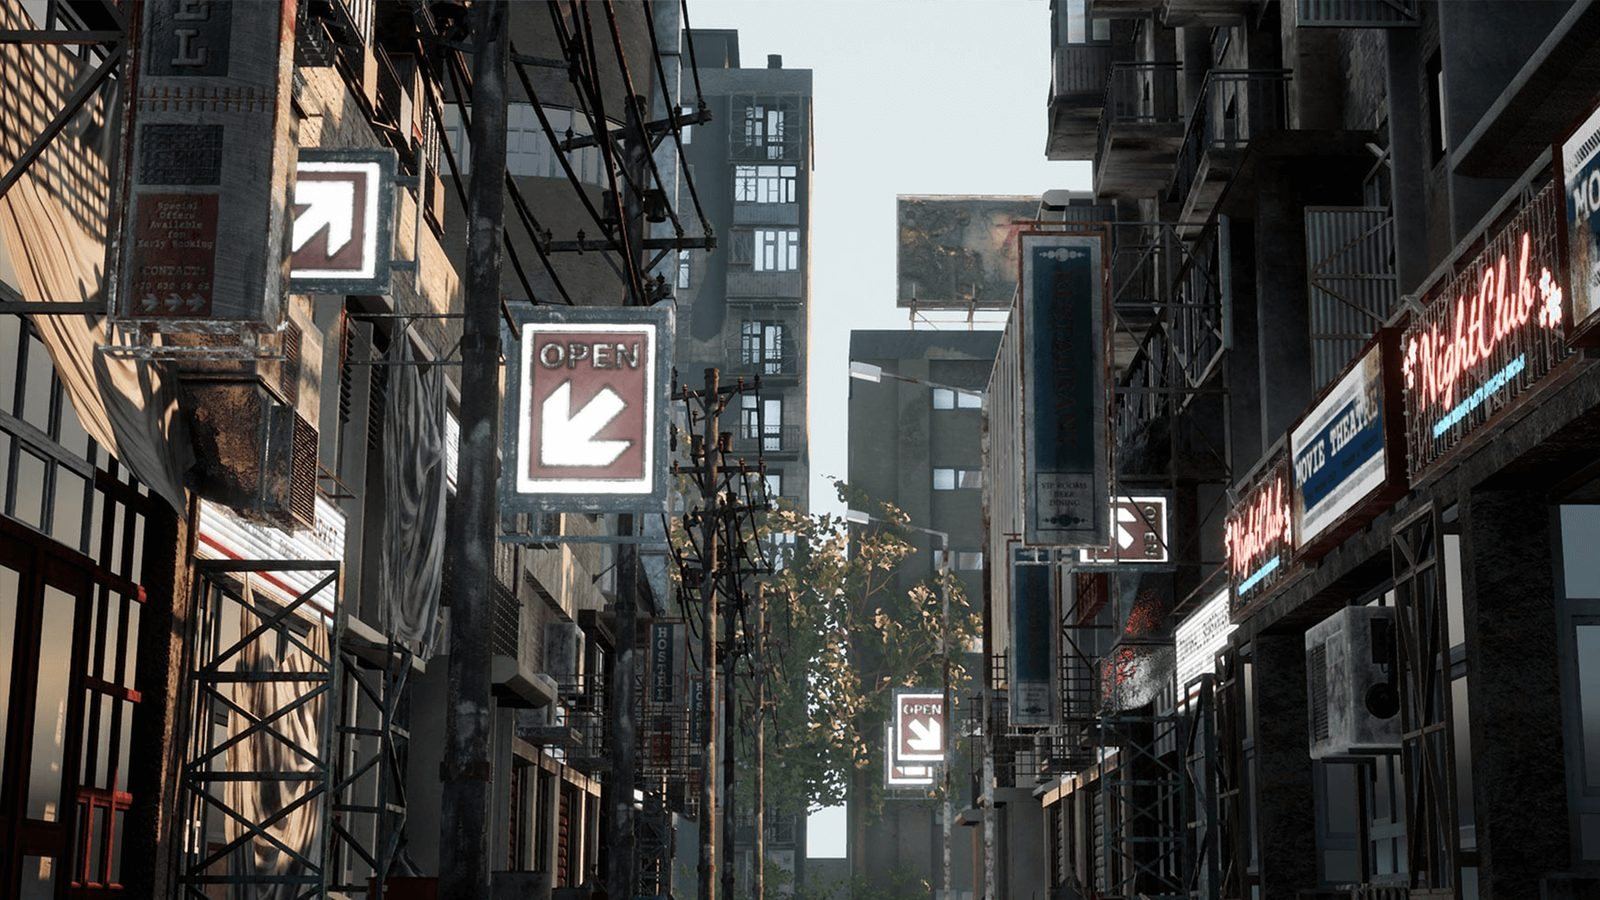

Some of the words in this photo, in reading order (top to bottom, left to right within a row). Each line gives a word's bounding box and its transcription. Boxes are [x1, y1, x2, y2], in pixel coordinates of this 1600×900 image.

[539, 342, 639, 369] OPEN
[1295, 439, 1326, 490] MOVIE
[1329, 387, 1378, 457] THEATRE
[903, 704, 942, 715] OPEN
